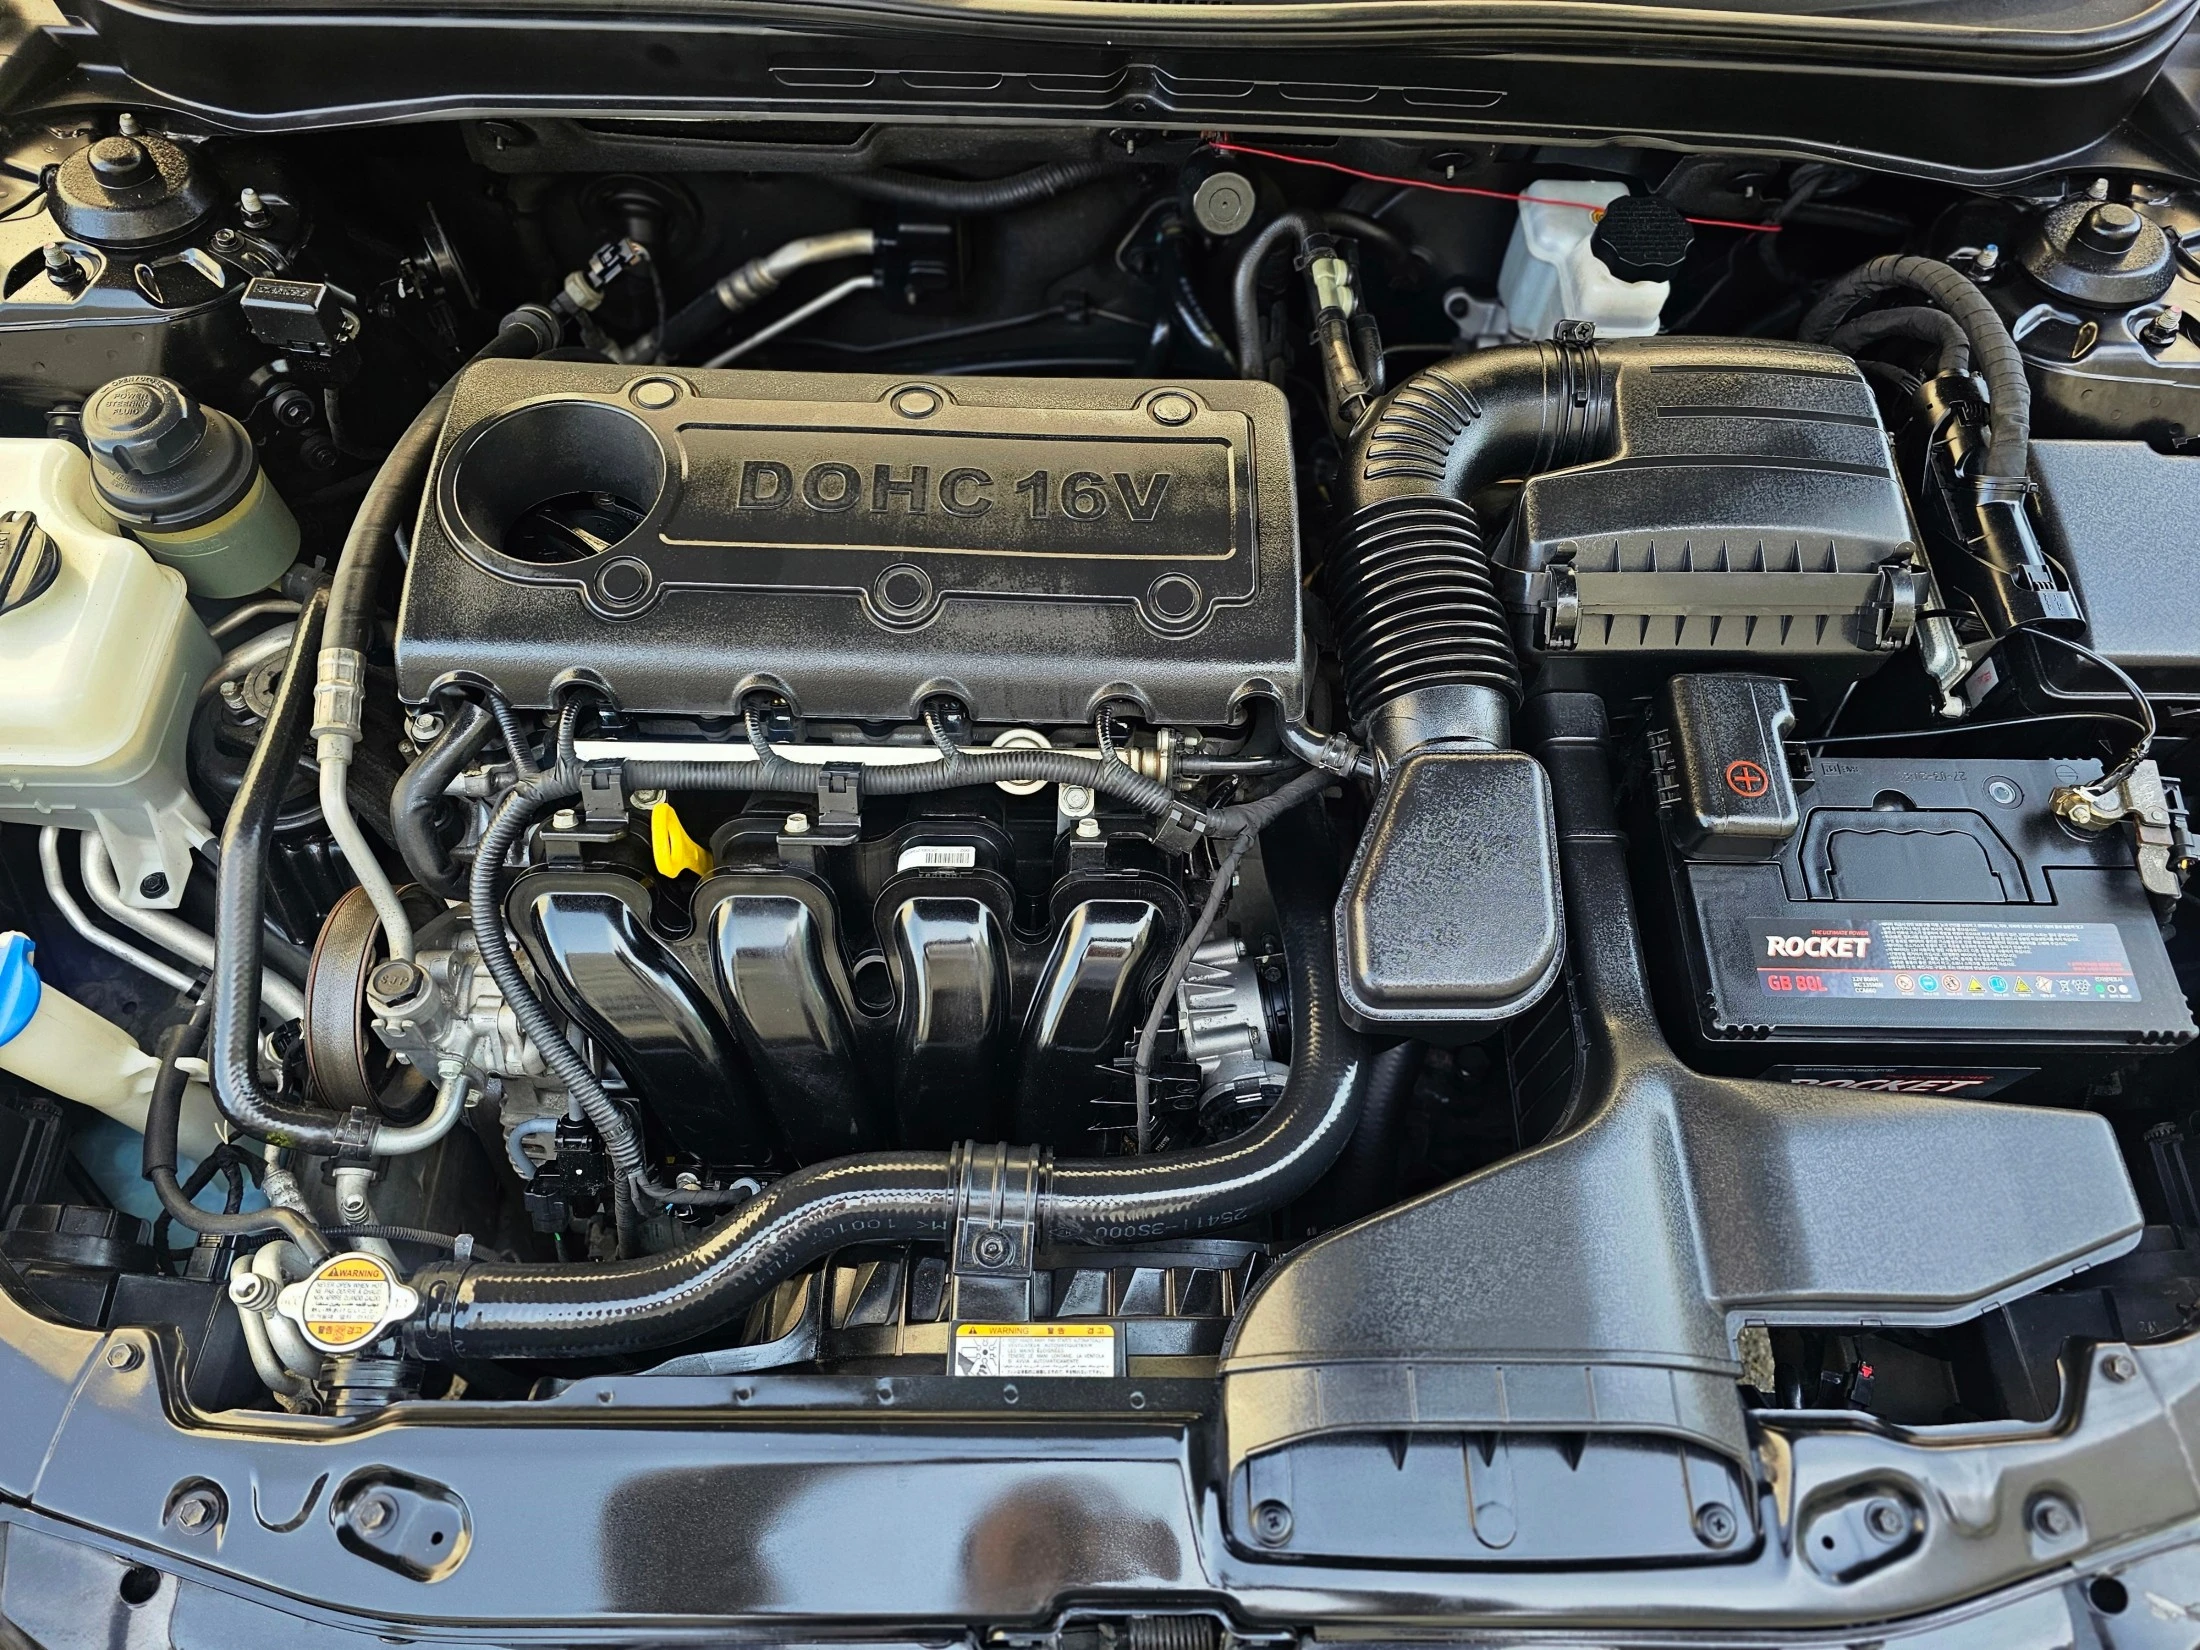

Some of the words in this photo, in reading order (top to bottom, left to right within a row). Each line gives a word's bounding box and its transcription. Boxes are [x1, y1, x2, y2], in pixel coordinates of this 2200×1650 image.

[113, 392, 149, 400] POWER
[112, 408, 139, 416] FLUID
[737, 460, 994, 518] DOHC
[1016, 470, 1172, 522] 16V
[1765, 935, 1871, 958] ROCKET
[381, 974, 409, 986] SJP
[1768, 974, 1793, 991] GB
[1095, 1207, 1248, 1239] 25411-3S000
[339, 1268, 380, 1279] WARNING
[989, 1327, 1029, 1335] WARNING
